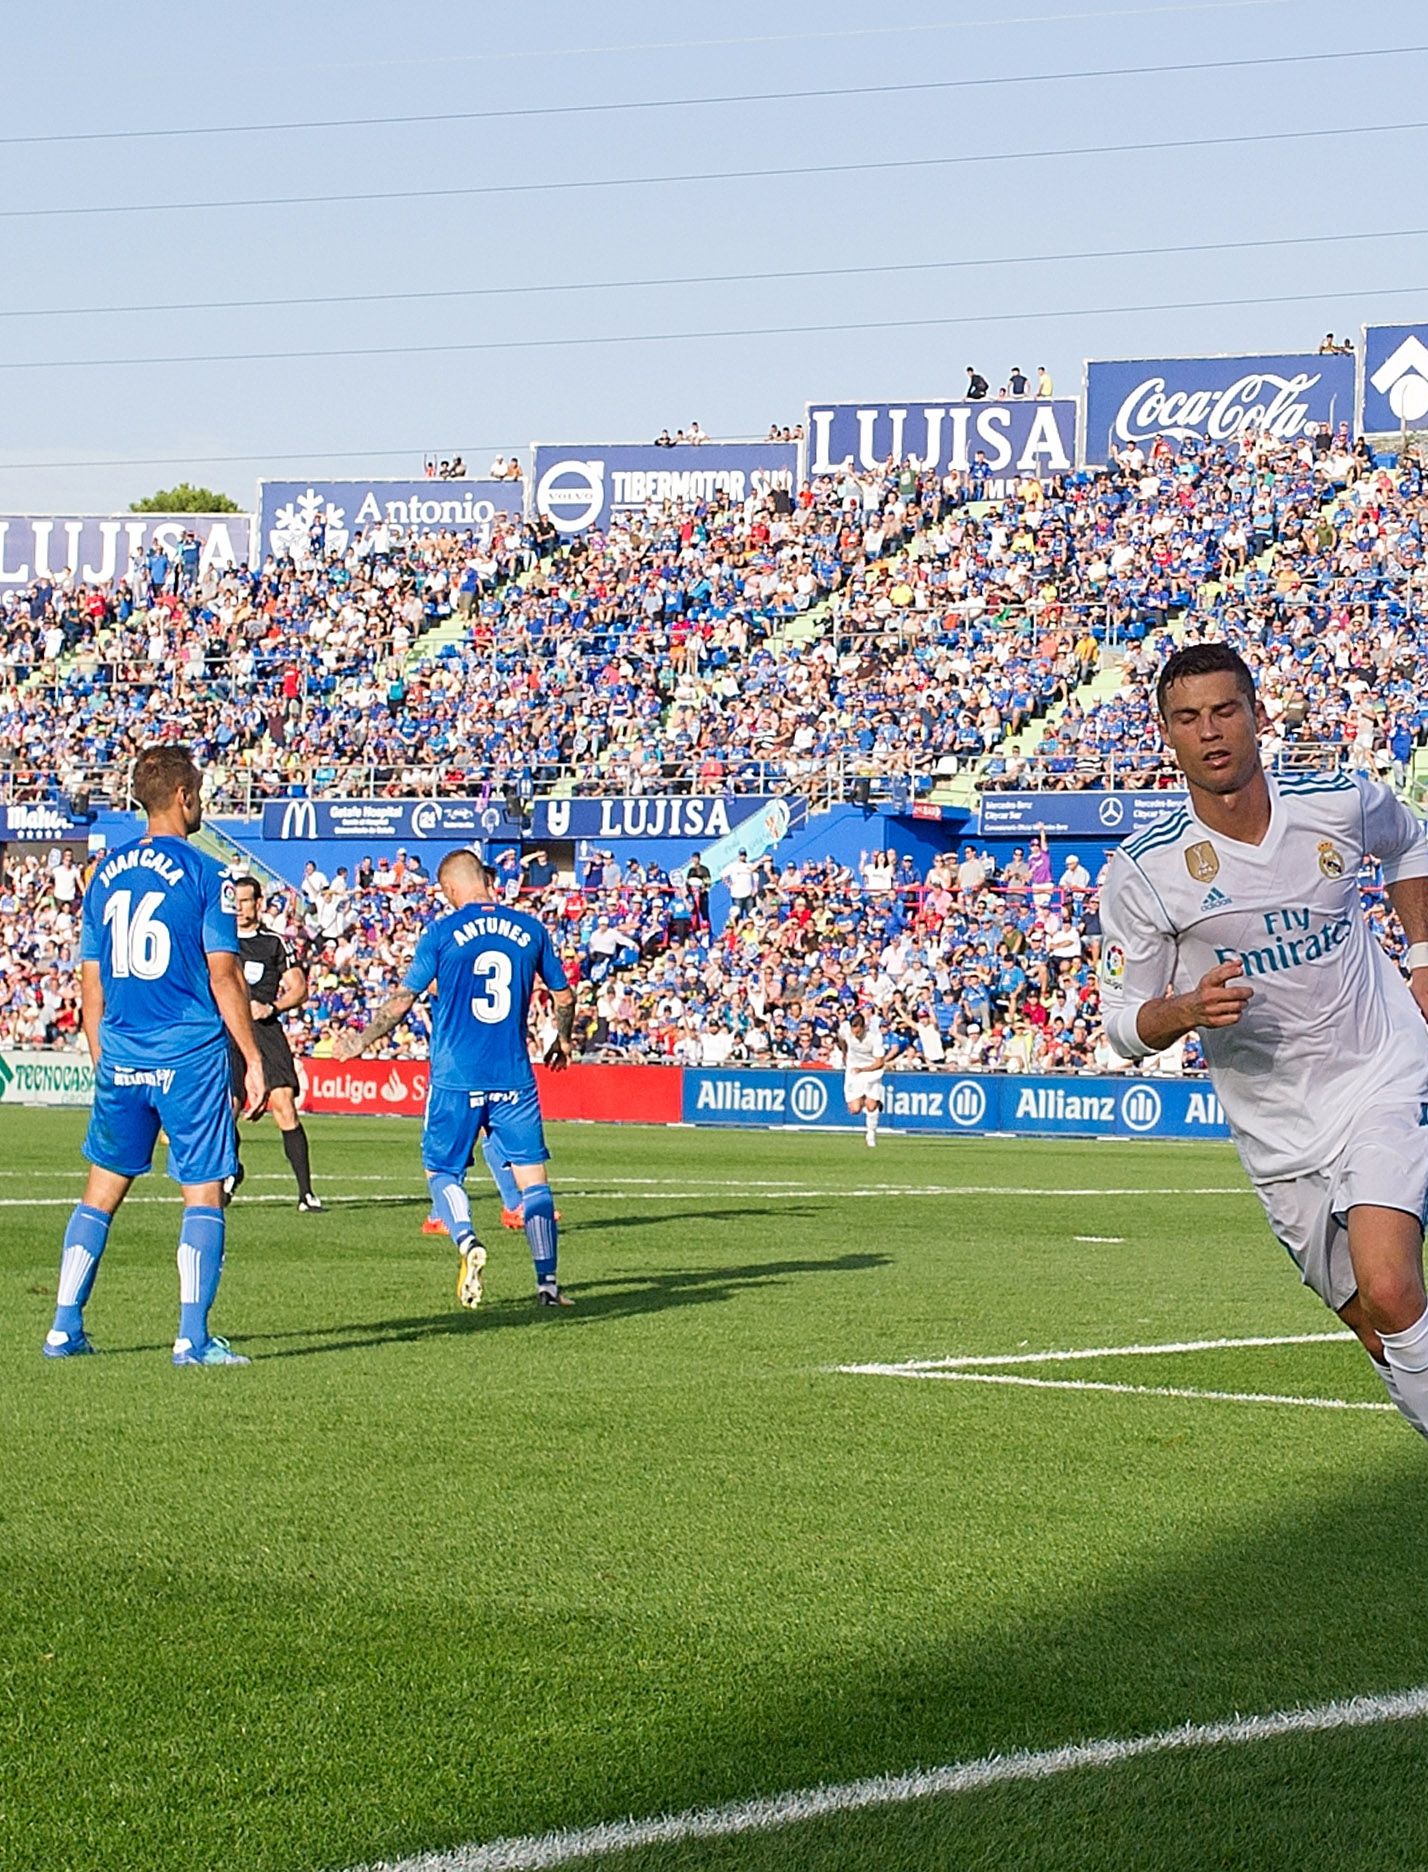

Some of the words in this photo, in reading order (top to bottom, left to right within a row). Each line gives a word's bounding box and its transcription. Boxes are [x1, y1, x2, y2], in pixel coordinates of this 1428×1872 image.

[1116, 373, 1322, 442] Coca-Cola
[811, 406, 1071, 475] LUJISA
[611, 470, 745, 502] TIBERMOTOR
[354, 491, 495, 524] Antonio
[600, 799, 730, 836] LUJISA
[103, 890, 171, 980] 16
[453, 917, 531, 947] ANTUNES
[1263, 908, 1311, 935] Fly
[1214, 919, 1352, 976] Emirate
[472, 950, 512, 1024] 3
[313, 1073, 377, 1104] LaLiga
[696, 1081, 786, 1110] Allianz
[1016, 1088, 1115, 1121] Allianz
